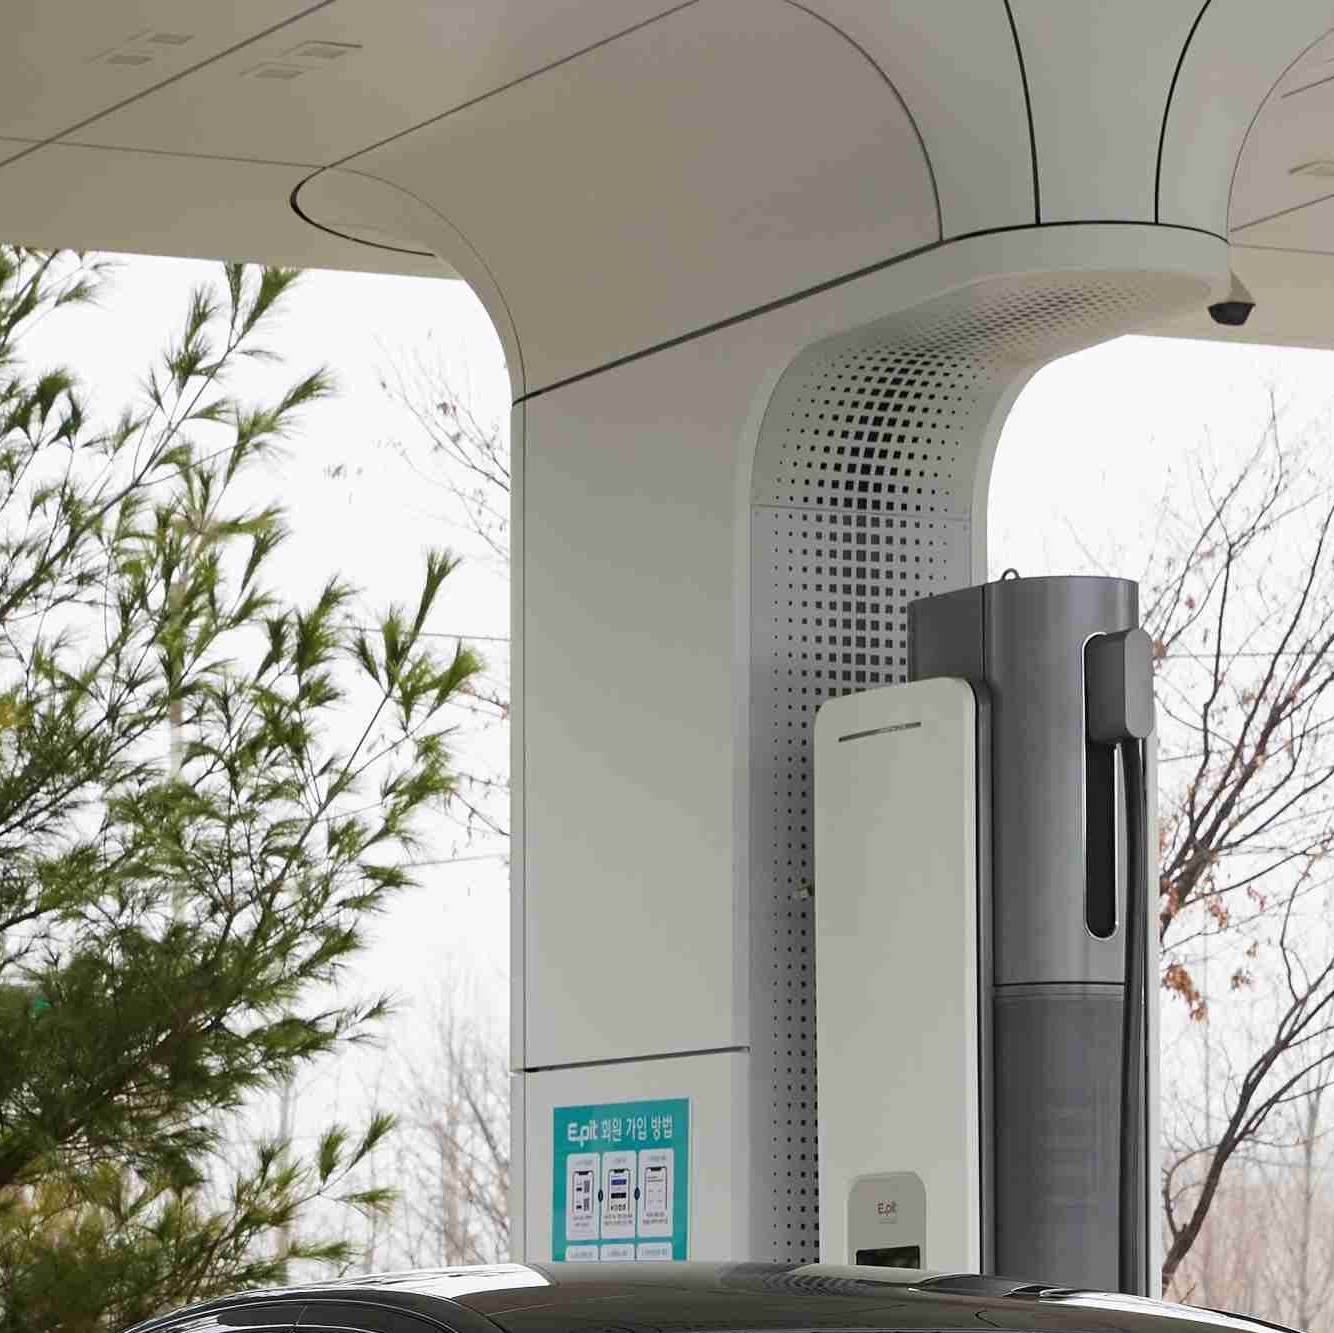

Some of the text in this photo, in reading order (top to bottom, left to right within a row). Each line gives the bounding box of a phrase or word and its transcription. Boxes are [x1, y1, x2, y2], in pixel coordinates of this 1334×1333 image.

[601, 1117, 622, 1142] 회원
[626, 1116, 647, 1141] 가입
[651, 1113, 673, 1140] 방법
